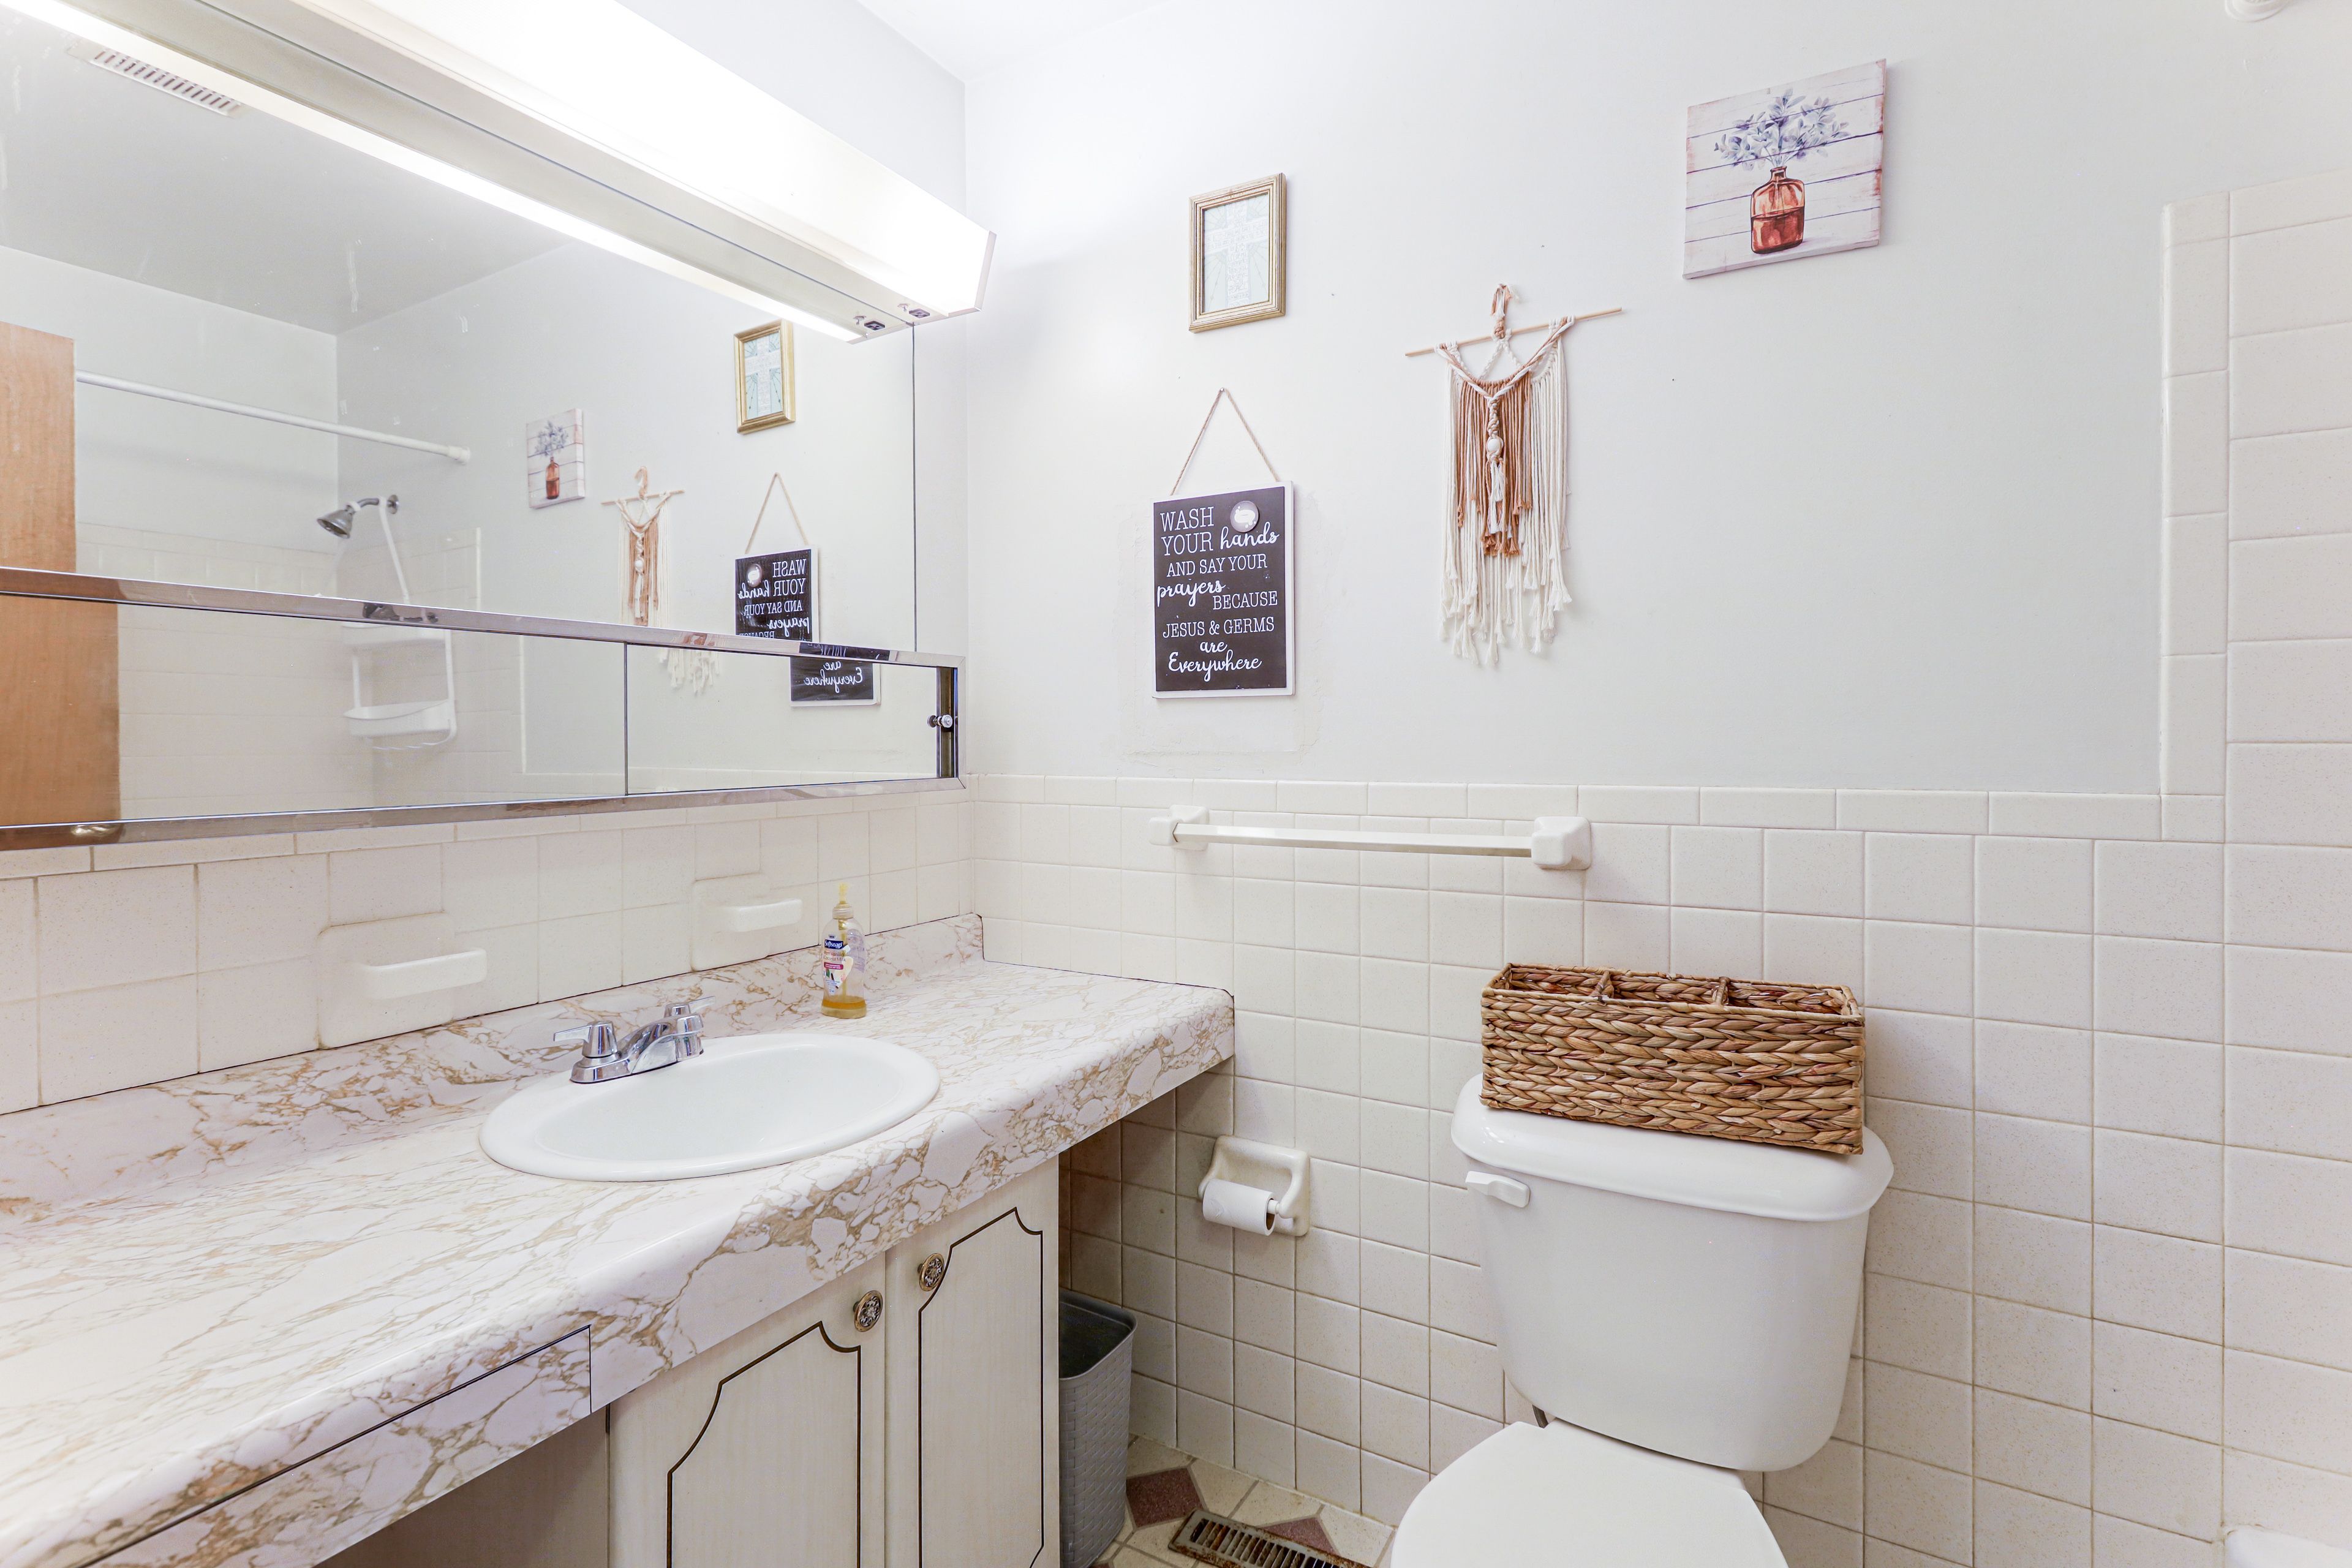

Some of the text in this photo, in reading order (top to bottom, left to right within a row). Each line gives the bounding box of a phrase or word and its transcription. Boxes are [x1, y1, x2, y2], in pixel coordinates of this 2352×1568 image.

[1160, 507, 1215, 532] WASH
[1161, 521, 1280, 556] YOUR hands
[1166, 553, 1268, 578] AND SAY YOUR
[1156, 579, 1278, 610] prayers BECAUSE
[1163, 616, 1275, 638] JESUS & GERMS
[1199, 641, 1227, 654] are
[1168, 649, 1262, 682] Everywhere
[824, 940, 842, 949] Softsoap
